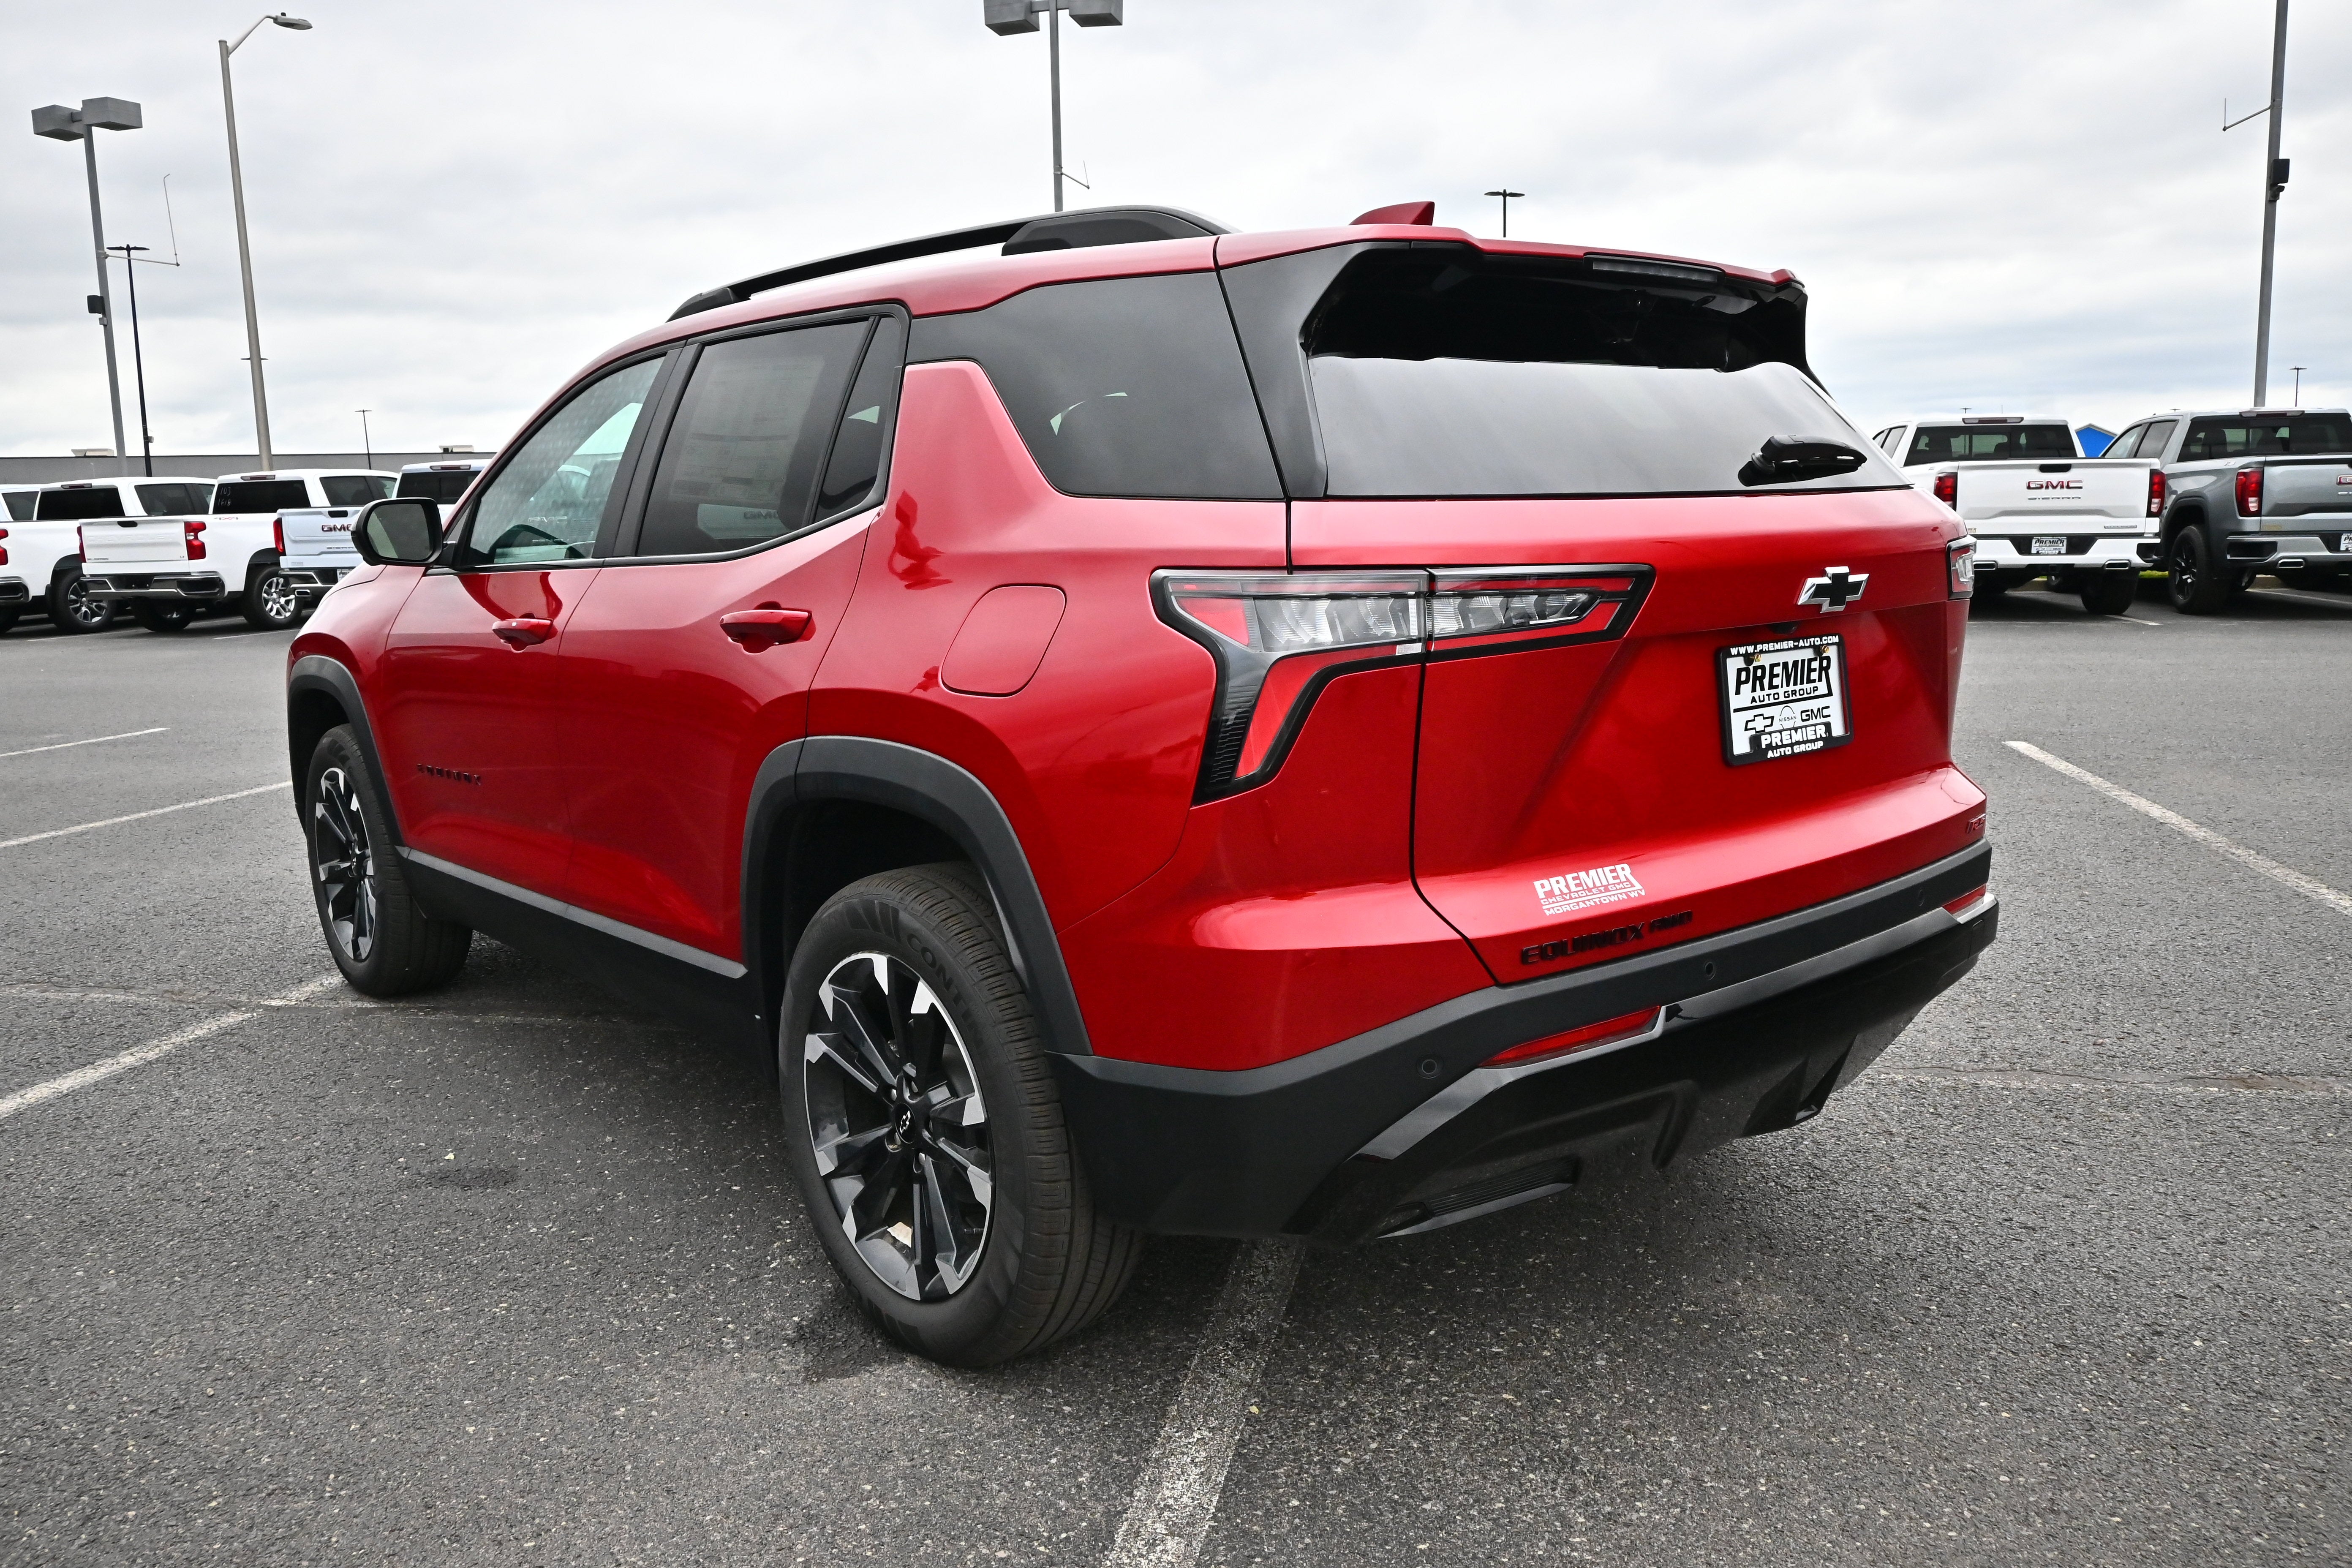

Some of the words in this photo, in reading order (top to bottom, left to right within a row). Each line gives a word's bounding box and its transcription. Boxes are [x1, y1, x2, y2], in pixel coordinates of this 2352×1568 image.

[2026, 480, 2083, 490] GMC
[1730, 635, 1839, 656] WWW.PREMIER-AUTO.COM
[1735, 655, 1832, 696] PREMIER
[1750, 692, 1780, 704] AUTO
[1783, 686, 1818, 699] GROUP
[1800, 705, 1831, 722] GMC
[1761, 724, 1827, 749] PREMIER
[1767, 746, 1792, 759] AUTO
[1794, 740, 1824, 754] GROUP
[1533, 863, 1637, 899] PREMIER
[1540, 886, 1605, 905] CHEVROLET
[1608, 882, 1631, 891] GMC
[1544, 893, 1628, 916] MORGANTOWN
[1628, 889, 1646, 897] WV
[1522, 922, 1644, 964] EQUINOX
[1650, 909, 1693, 933] AWD
